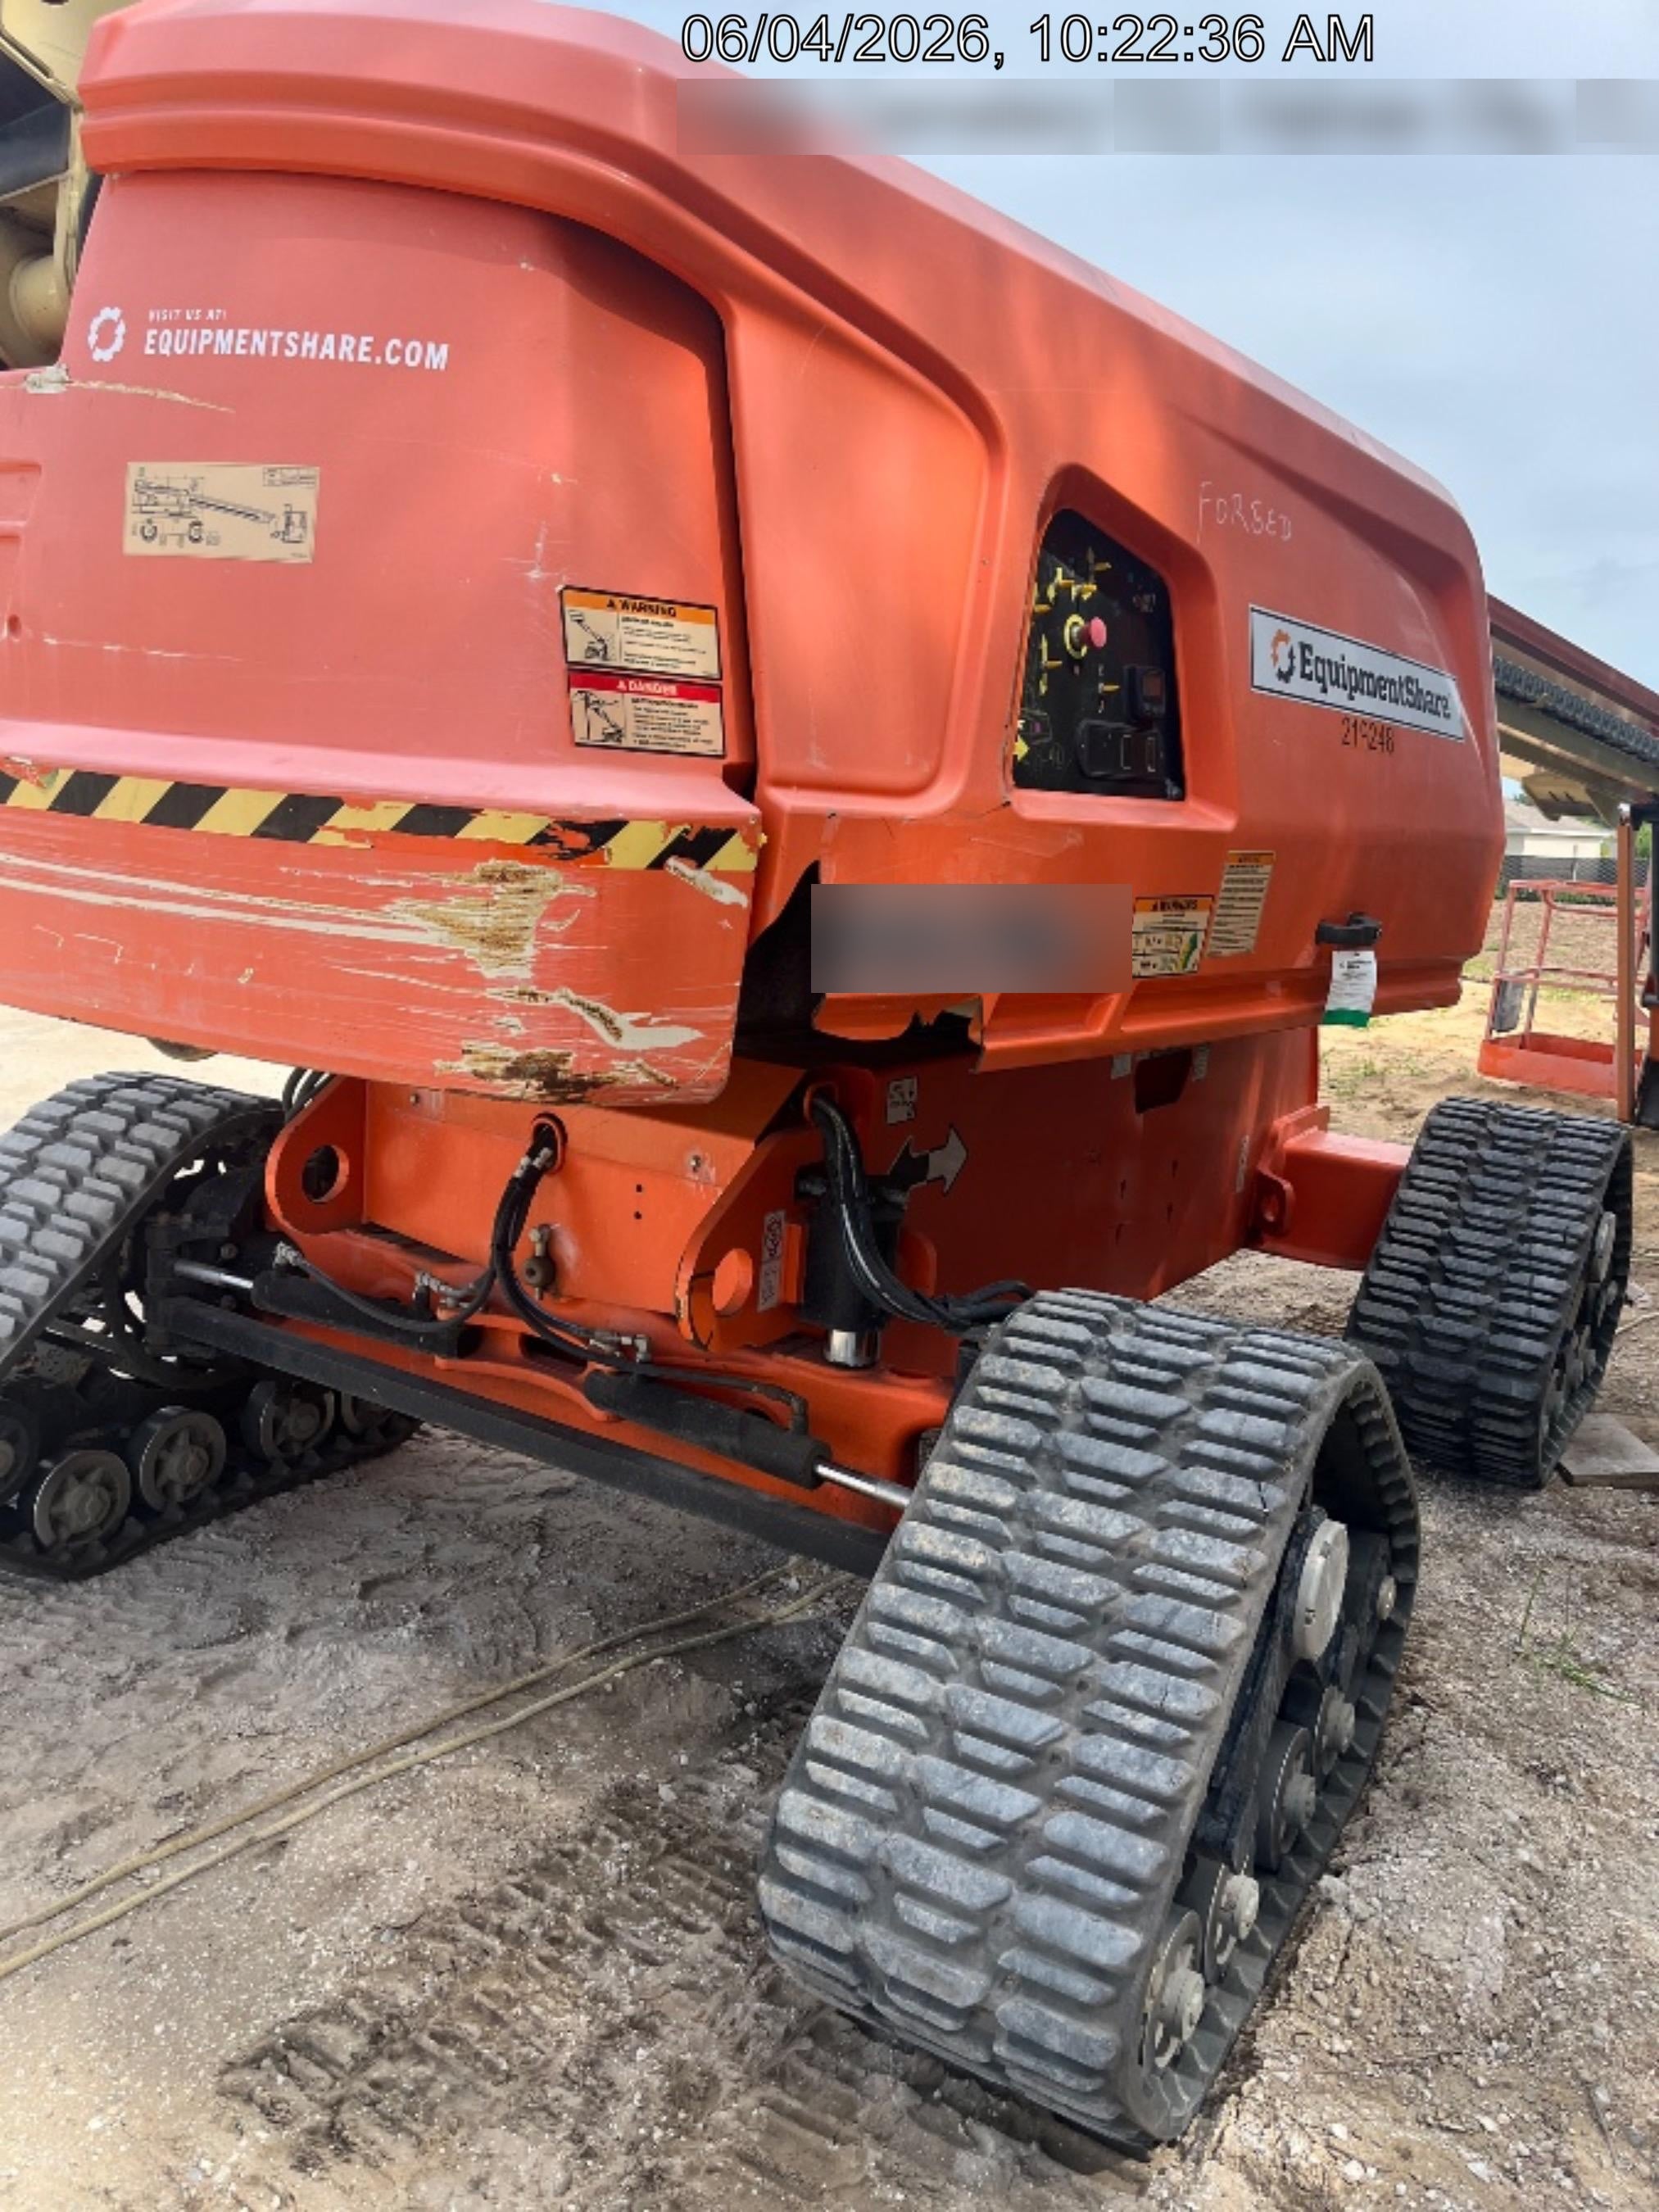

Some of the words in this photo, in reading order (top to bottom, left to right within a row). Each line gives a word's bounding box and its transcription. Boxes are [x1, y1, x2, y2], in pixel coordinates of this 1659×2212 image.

[148, 309, 181, 322] VISIT
[185, 309, 202, 320] US
[144, 329, 450, 371] EQUIPMENTSHARE.COM
[1299, 641, 1452, 719] EquipmentShare
